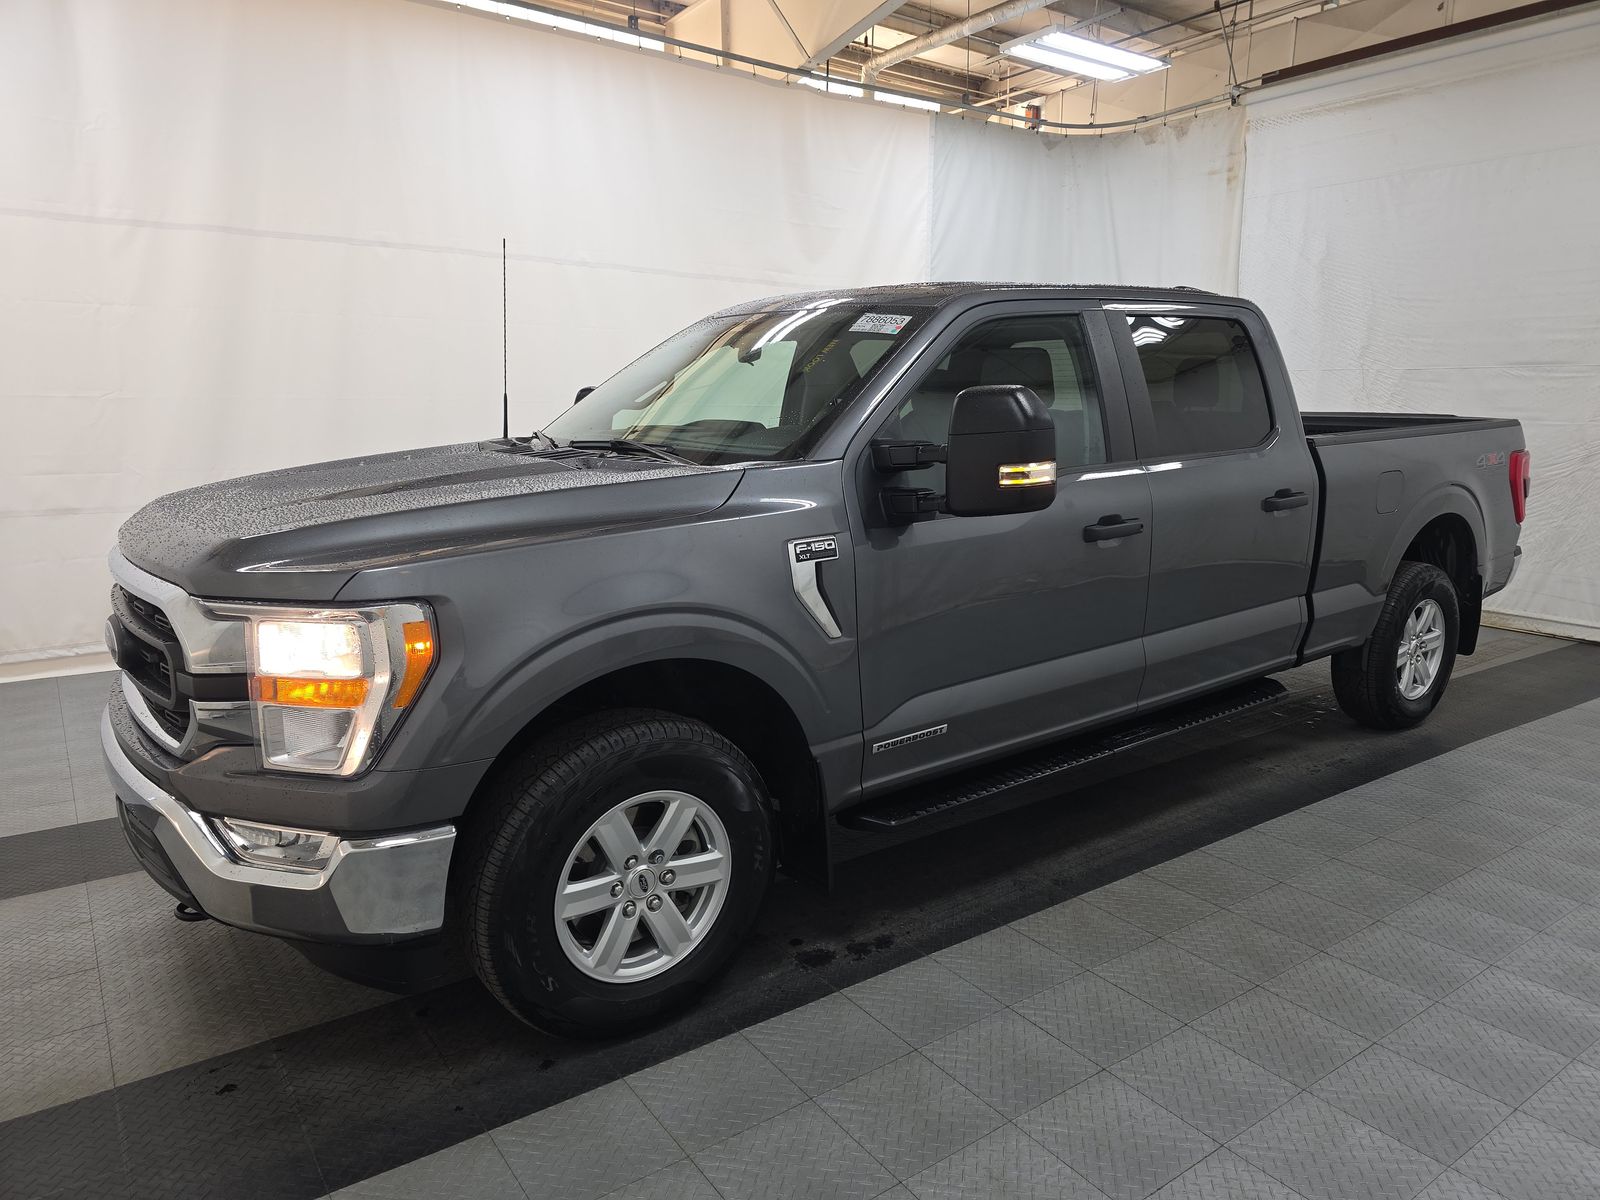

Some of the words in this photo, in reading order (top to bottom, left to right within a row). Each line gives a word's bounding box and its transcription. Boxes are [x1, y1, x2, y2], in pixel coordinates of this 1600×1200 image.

[860, 315, 906, 325] 7886053
[795, 540, 836, 554] F-150
[876, 727, 945, 752] POWERBOOST
